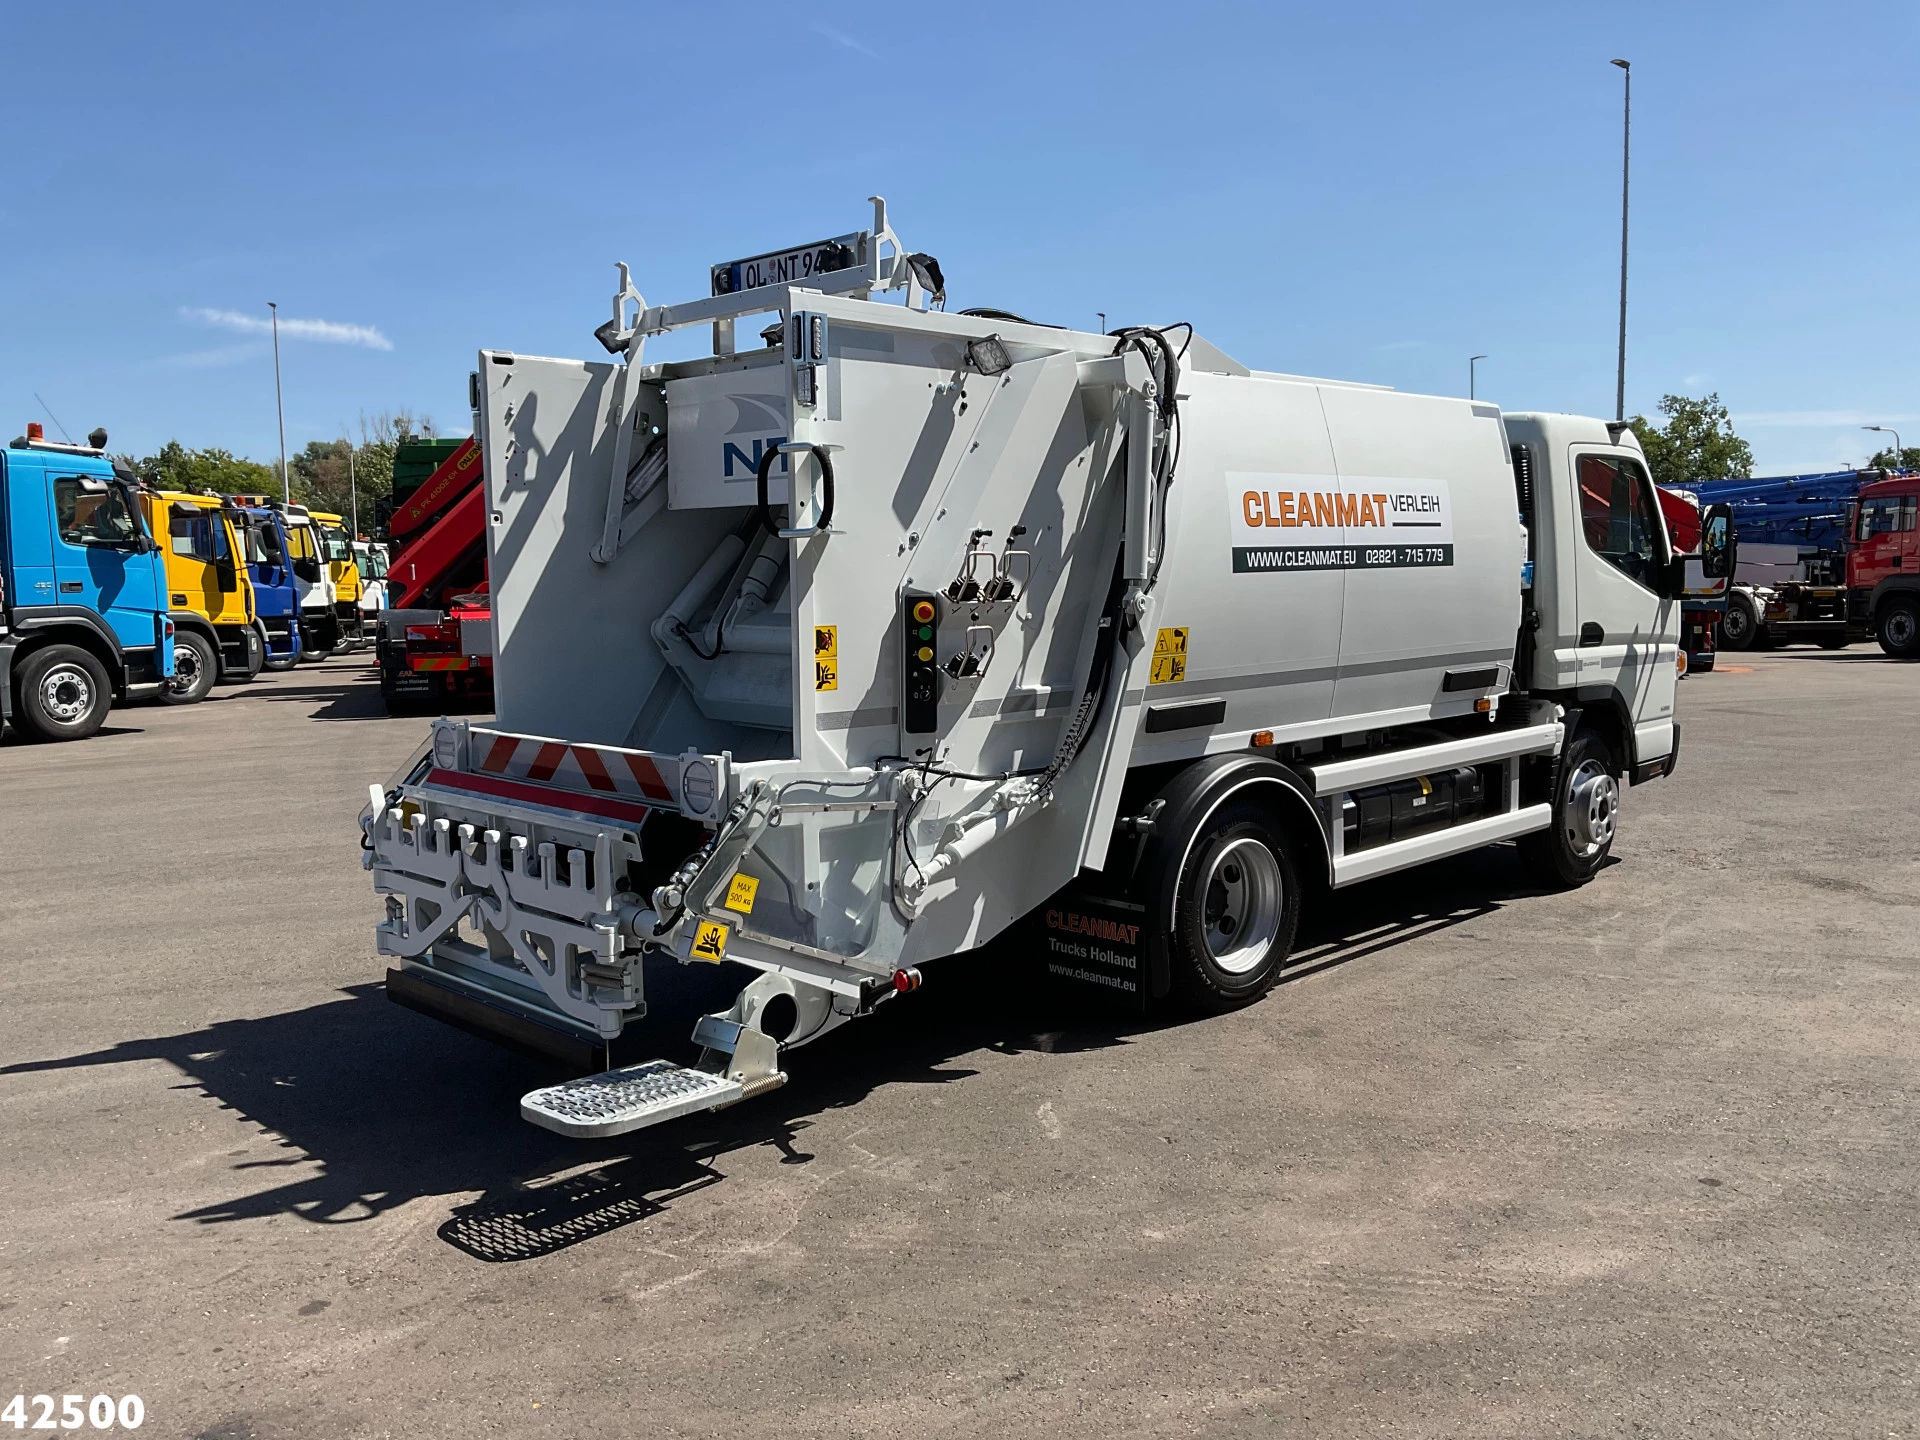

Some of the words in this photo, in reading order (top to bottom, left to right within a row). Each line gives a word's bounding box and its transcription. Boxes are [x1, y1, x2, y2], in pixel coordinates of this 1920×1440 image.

[746, 263, 767, 289] OL
[777, 254, 799, 282] NT
[1242, 490, 1387, 528] CLEANMAT
[1389, 494, 1441, 512] VERLEIH
[1246, 550, 1356, 568] WWW.CLEANMAT.EU
[1365, 549, 1397, 564] 02821
[1405, 548, 1423, 563] 715
[1425, 548, 1443, 562] 779
[729, 892, 742, 903] 500
[736, 882, 752, 893] MAX
[1046, 909, 1139, 945] CLEANMAT
[1049, 937, 1087, 958] Trucks
[1090, 946, 1137, 969] Holland
[1049, 963, 1136, 992] www.cleanmat.eu
